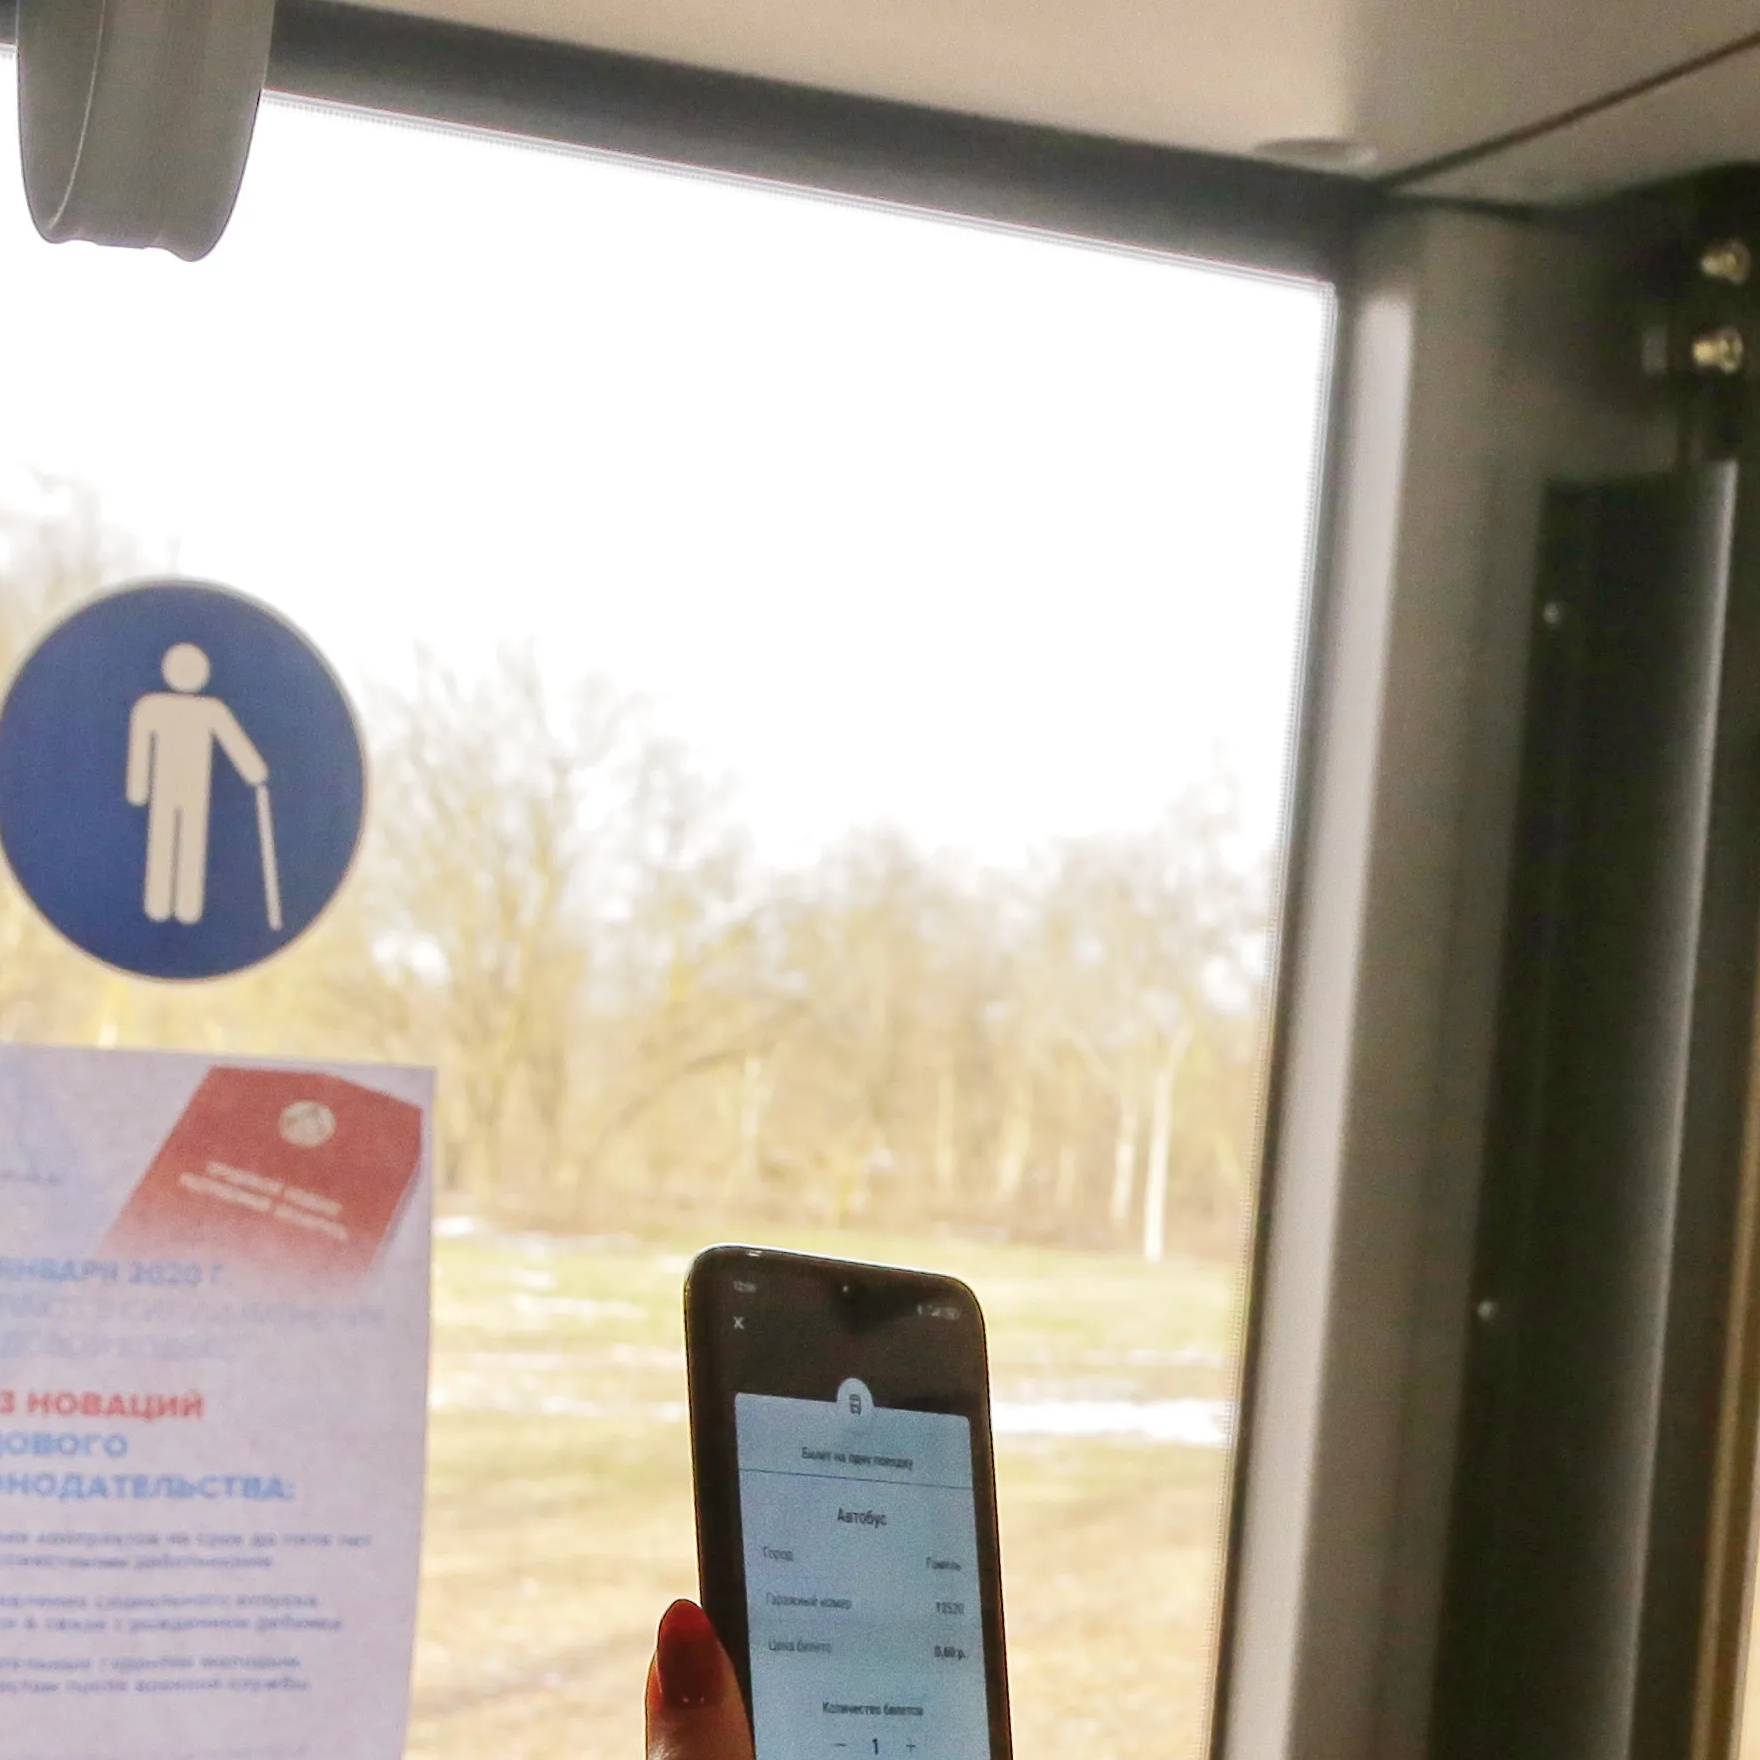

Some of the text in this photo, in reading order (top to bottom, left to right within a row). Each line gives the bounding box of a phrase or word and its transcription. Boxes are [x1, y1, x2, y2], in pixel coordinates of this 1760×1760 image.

[26, 1388, 205, 1422] НОВАЦИЙ
[837, 1507, 888, 1529] Автобус
[822, 1701, 881, 1716] Количество
[871, 1737, 879, 1756] 1
